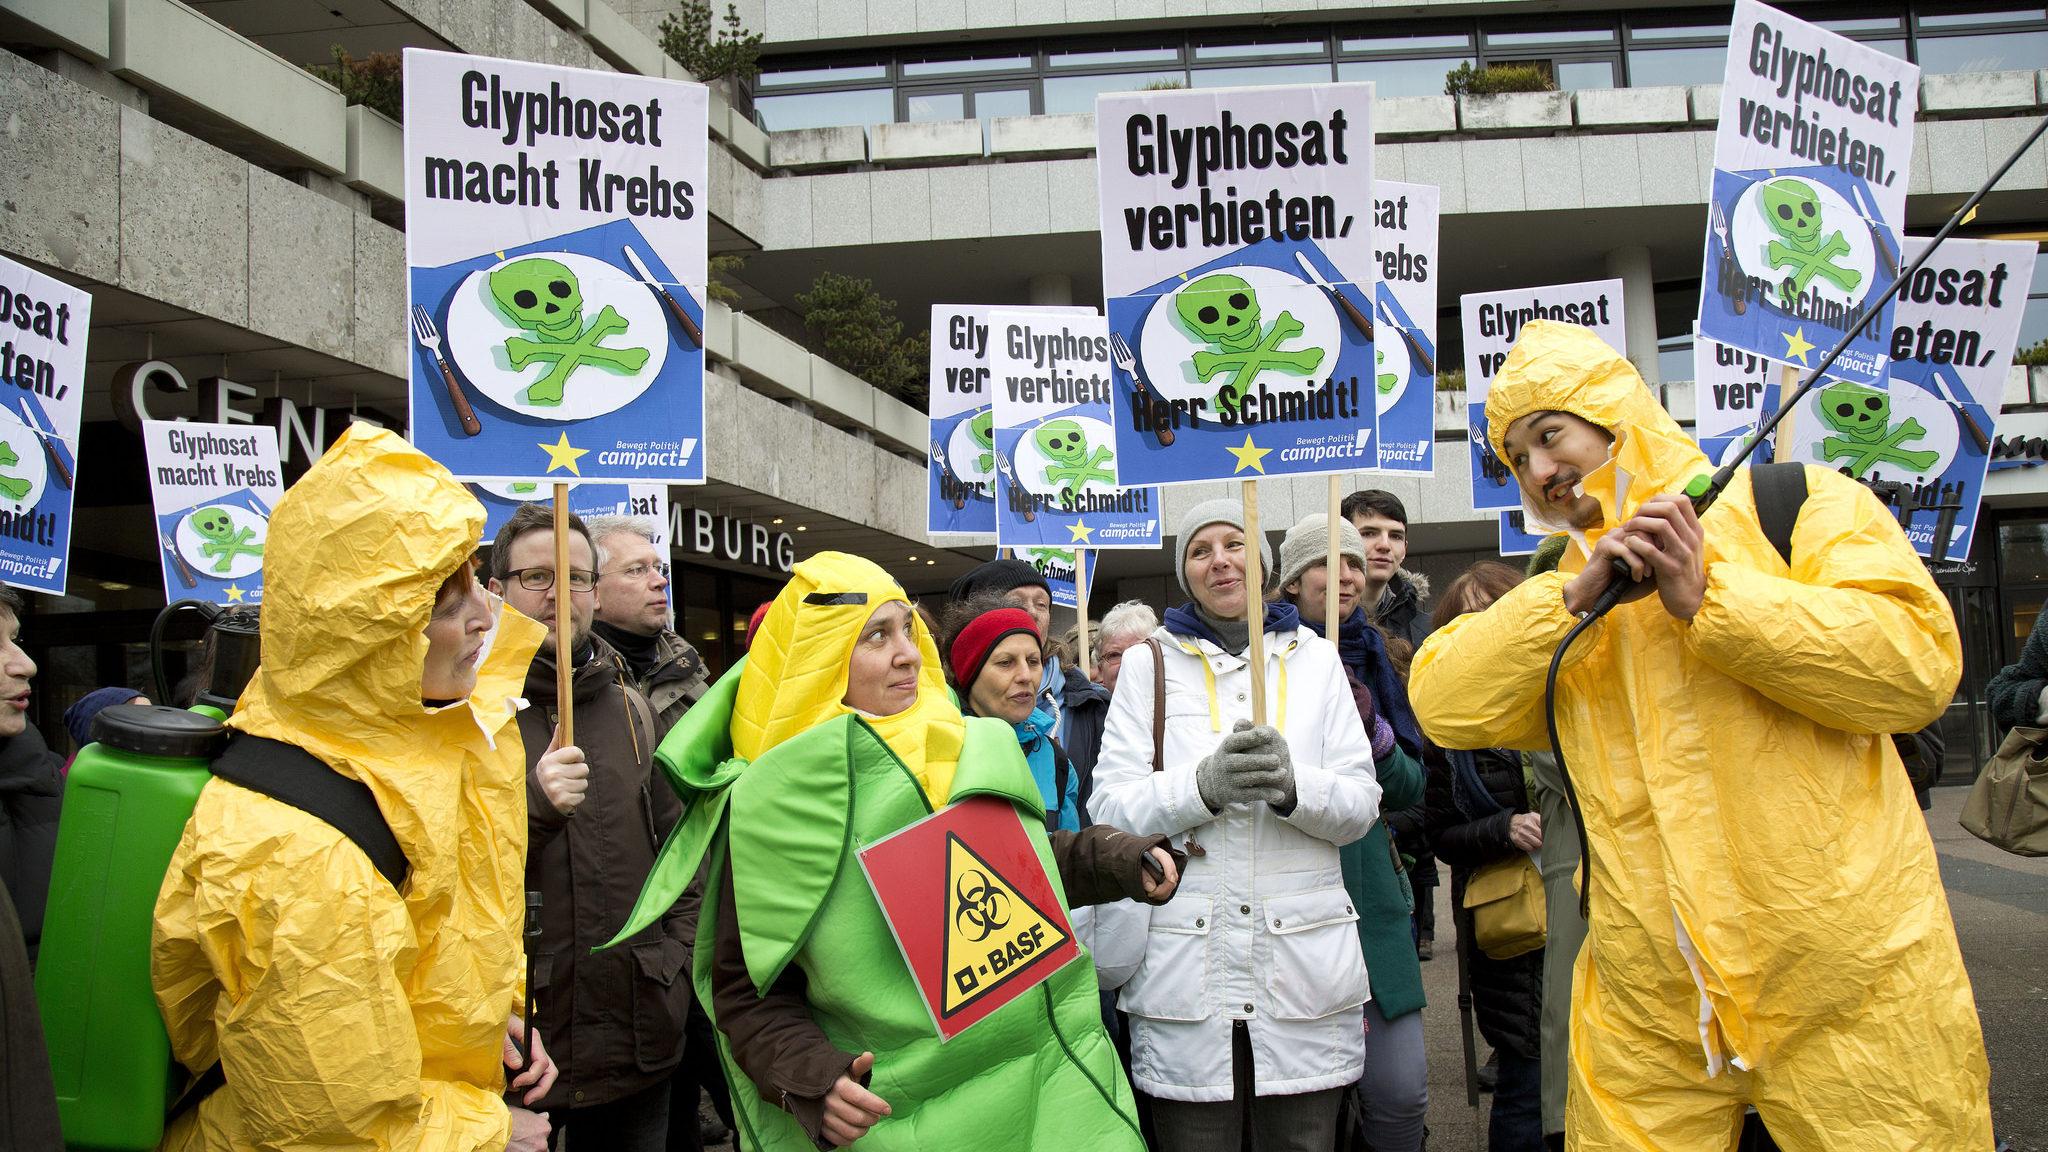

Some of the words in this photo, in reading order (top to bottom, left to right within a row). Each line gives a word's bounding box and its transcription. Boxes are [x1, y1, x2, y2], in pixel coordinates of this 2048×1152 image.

[1749, 22, 1901, 127] Glyphosat
[462, 70, 662, 147] Glyphosat
[1126, 109, 1348, 189] Glyphosat
[1740, 98, 1896, 187] verbieten,
[425, 152, 559, 209] macht
[579, 158, 694, 220] Krebs
[1124, 186, 1353, 250] verbieten,
[1717, 257, 1772, 308] Herr
[1132, 391, 1207, 432] Herr
[1218, 377, 1359, 427] Schmidt!
[168, 429, 258, 460] Glyphosat
[598, 438, 697, 469] campact!
[616, 440, 647, 450] Bewegt
[650, 441, 679, 450] Politik
[1280, 429, 1371, 463] campact!
[1296, 437, 1326, 446] Bewegt
[1328, 434, 1355, 443] Politik
[157, 463, 217, 486] macht
[224, 464, 277, 487] Krebs
[1009, 487, 1055, 513] Herr
[1060, 486, 1148, 514] Schmidt!
[1100, 520, 1157, 539] campact!
[25, 555, 48, 566] Politik
[986, 922, 1044, 975] BASF
